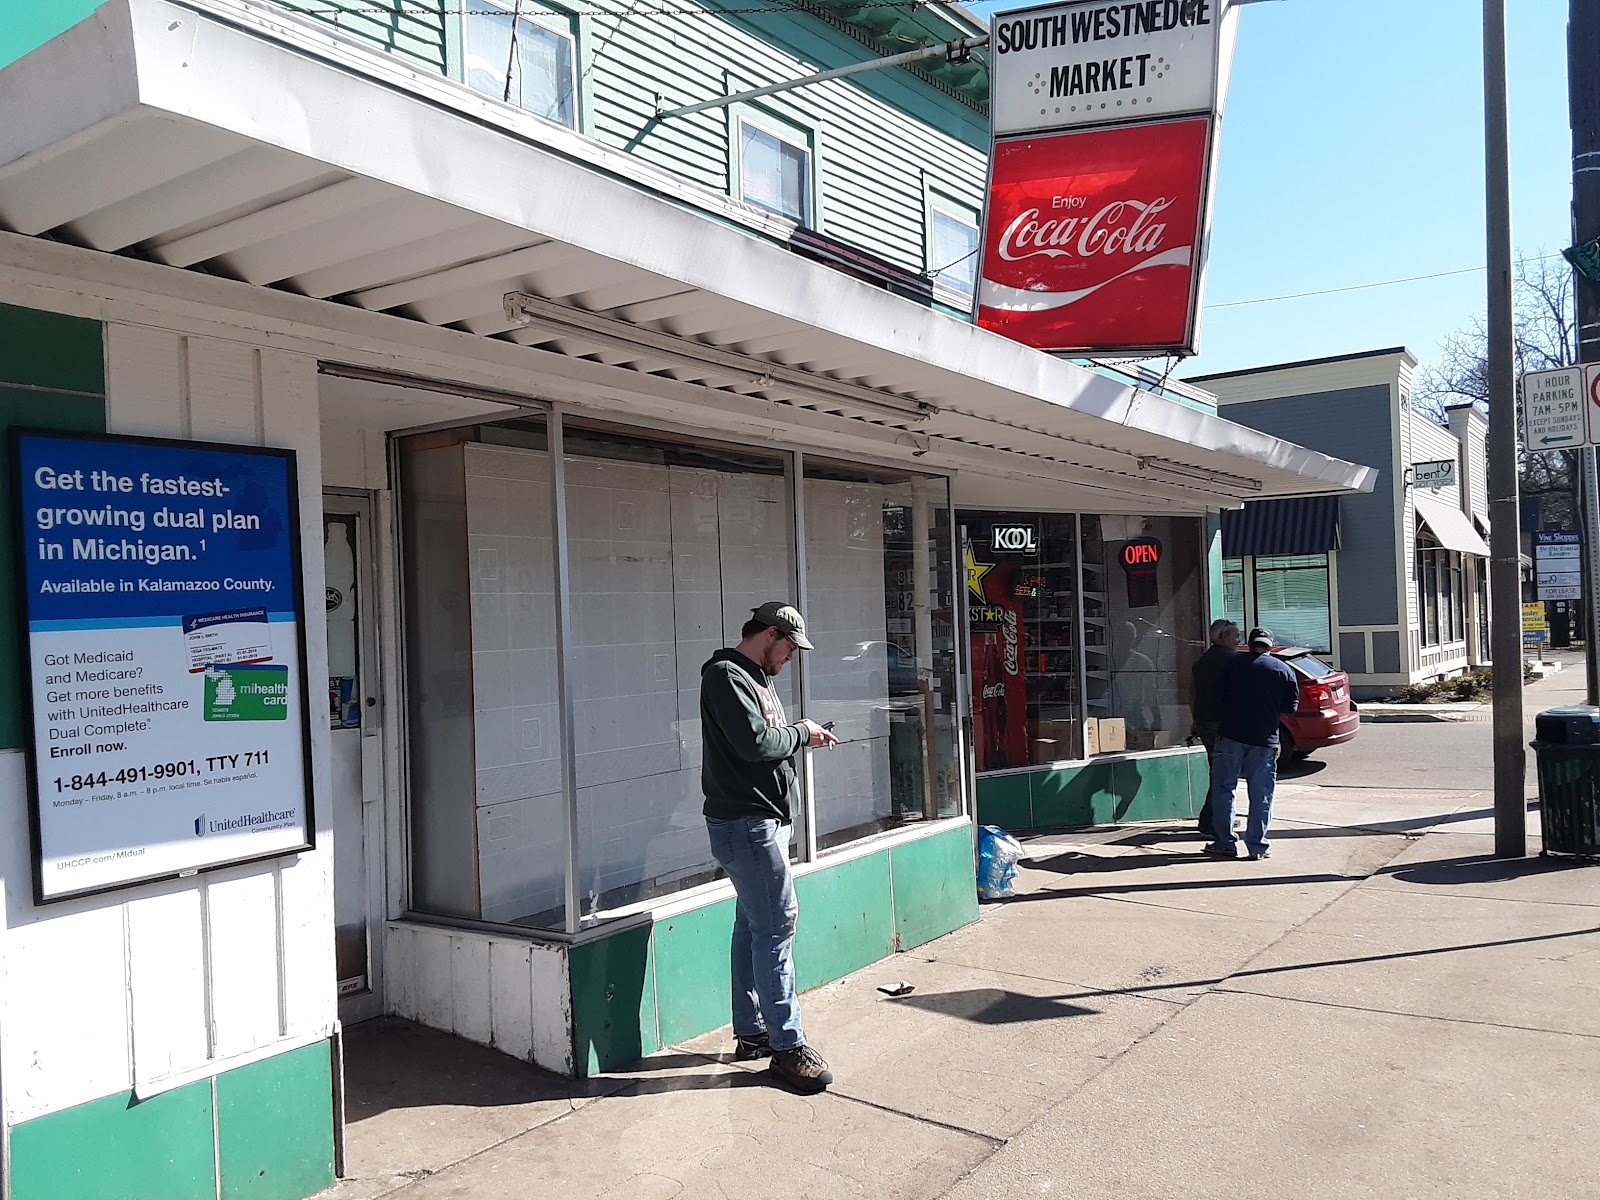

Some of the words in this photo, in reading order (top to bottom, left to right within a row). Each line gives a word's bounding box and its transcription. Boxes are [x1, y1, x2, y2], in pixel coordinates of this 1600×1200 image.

[997, 18, 1071, 54] SOUTH
[1050, 54, 1151, 98] MARKET
[1052, 195, 1087, 211] Enjoy
[998, 196, 1177, 261] Coca-Cola
[1536, 379, 1540, 389] 1
[1545, 376, 1570, 388] HOUR
[1533, 388, 1574, 403] PARKING
[1529, 418, 1550, 426] EXCEPT
[1553, 414, 1581, 424] SUNDAYS
[1548, 423, 1578, 434] HOLIDAYS
[34, 466, 84, 490] Get
[92, 470, 134, 492] the
[142, 473, 230, 498] fastest-
[37, 504, 145, 532] growing
[153, 507, 204, 529] dual
[212, 509, 260, 533] plan
[994, 528, 1037, 549] KOOL
[38, 538, 63, 560] in
[1125, 544, 1158, 564] OPEN
[40, 578, 115, 594] Available
[120, 579, 134, 592] in
[138, 578, 220, 592] Kalamazoo
[223, 578, 276, 592] County.
[44, 654, 70, 666] Got
[74, 650, 134, 664] Medicaid
[45, 672, 71, 684] and
[76, 667, 143, 682] Medicare?
[46, 691, 72, 703] Get
[75, 689, 110, 700] more
[114, 684, 164, 698] benefits
[240, 682, 288, 694] mihealth
[263, 695, 288, 705] card
[48, 709, 75, 721] with
[80, 700, 189, 718] UnitedHealthcare
[49, 726, 80, 740] Dual
[50, 744, 92, 758] Enroll
[96, 741, 128, 754] now.
[54, 760, 201, 793] 1-844-491-9901,
[206, 754, 240, 772] TTY
[244, 750, 269, 766] 711
[52, 798, 84, 808] Monday
[92, 794, 116, 802] Friday,
[152, 786, 167, 795] p.m.
[169, 783, 185, 791] local
[213, 776, 231, 784] habla
[251, 824, 283, 834] Community
